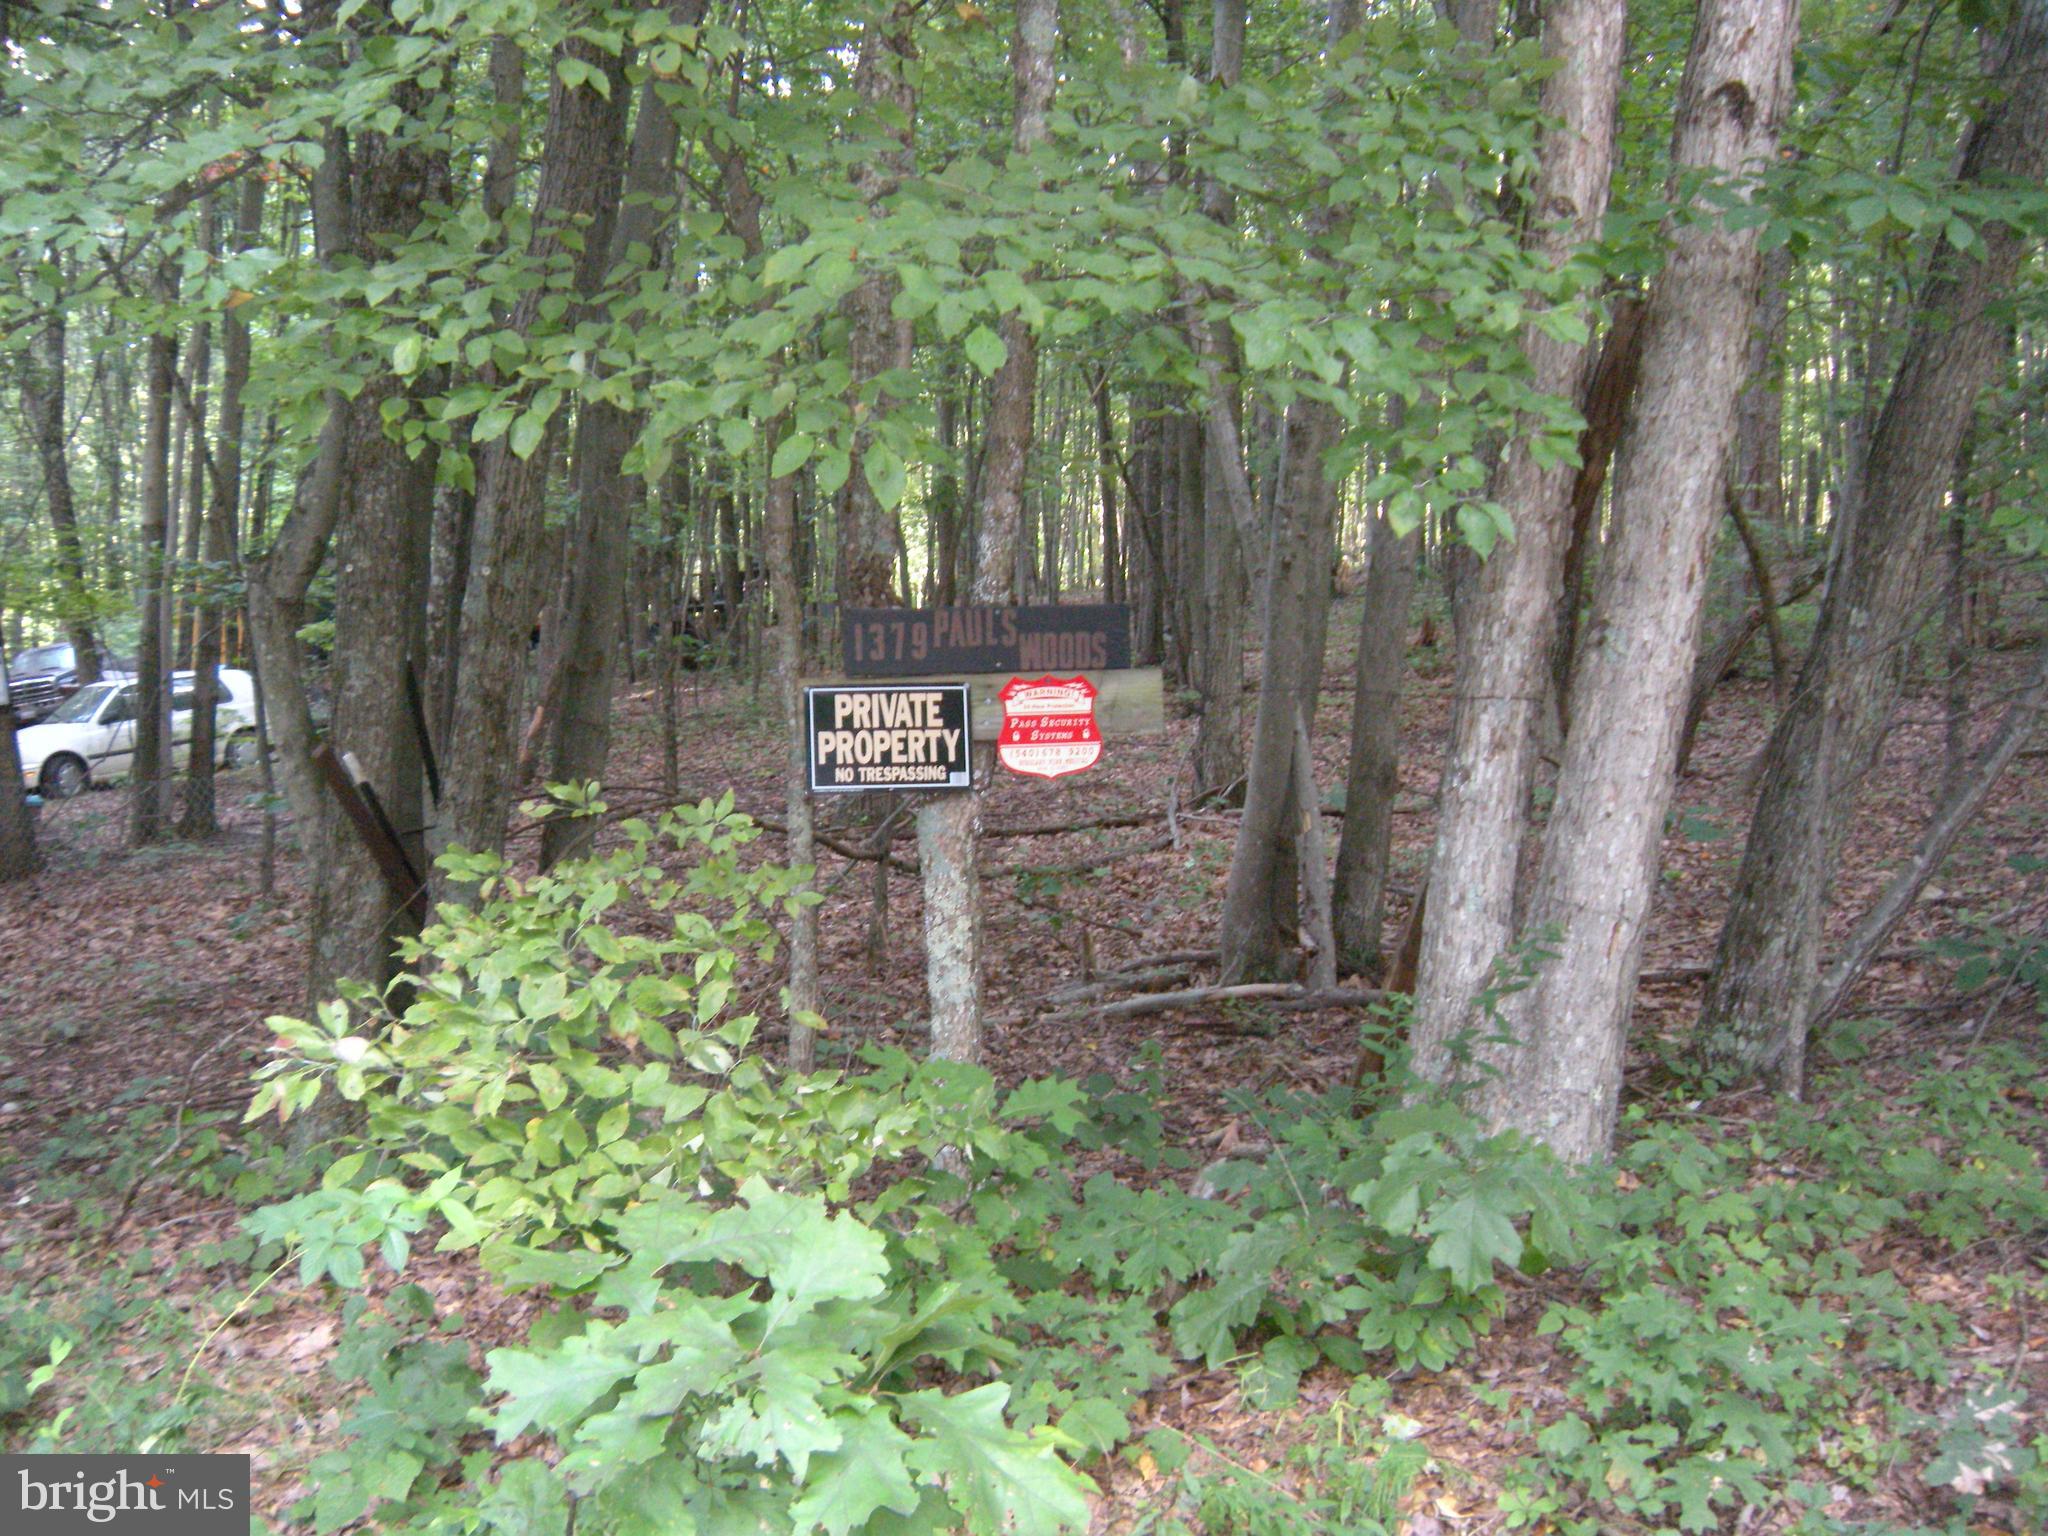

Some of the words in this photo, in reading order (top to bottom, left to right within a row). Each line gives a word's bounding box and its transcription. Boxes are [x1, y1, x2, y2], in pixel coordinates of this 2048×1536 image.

[854, 621, 928, 661] 1379
[1020, 631, 1107, 670] WOODS
[834, 692, 944, 729] PRIVATE
[1040, 716, 1091, 728] SECURITY
[818, 728, 961, 765] PROPERTY
[1030, 730, 1074, 741] SYSTEMS
[835, 767, 854, 782] NO
[858, 765, 947, 782] TRESPASSING
